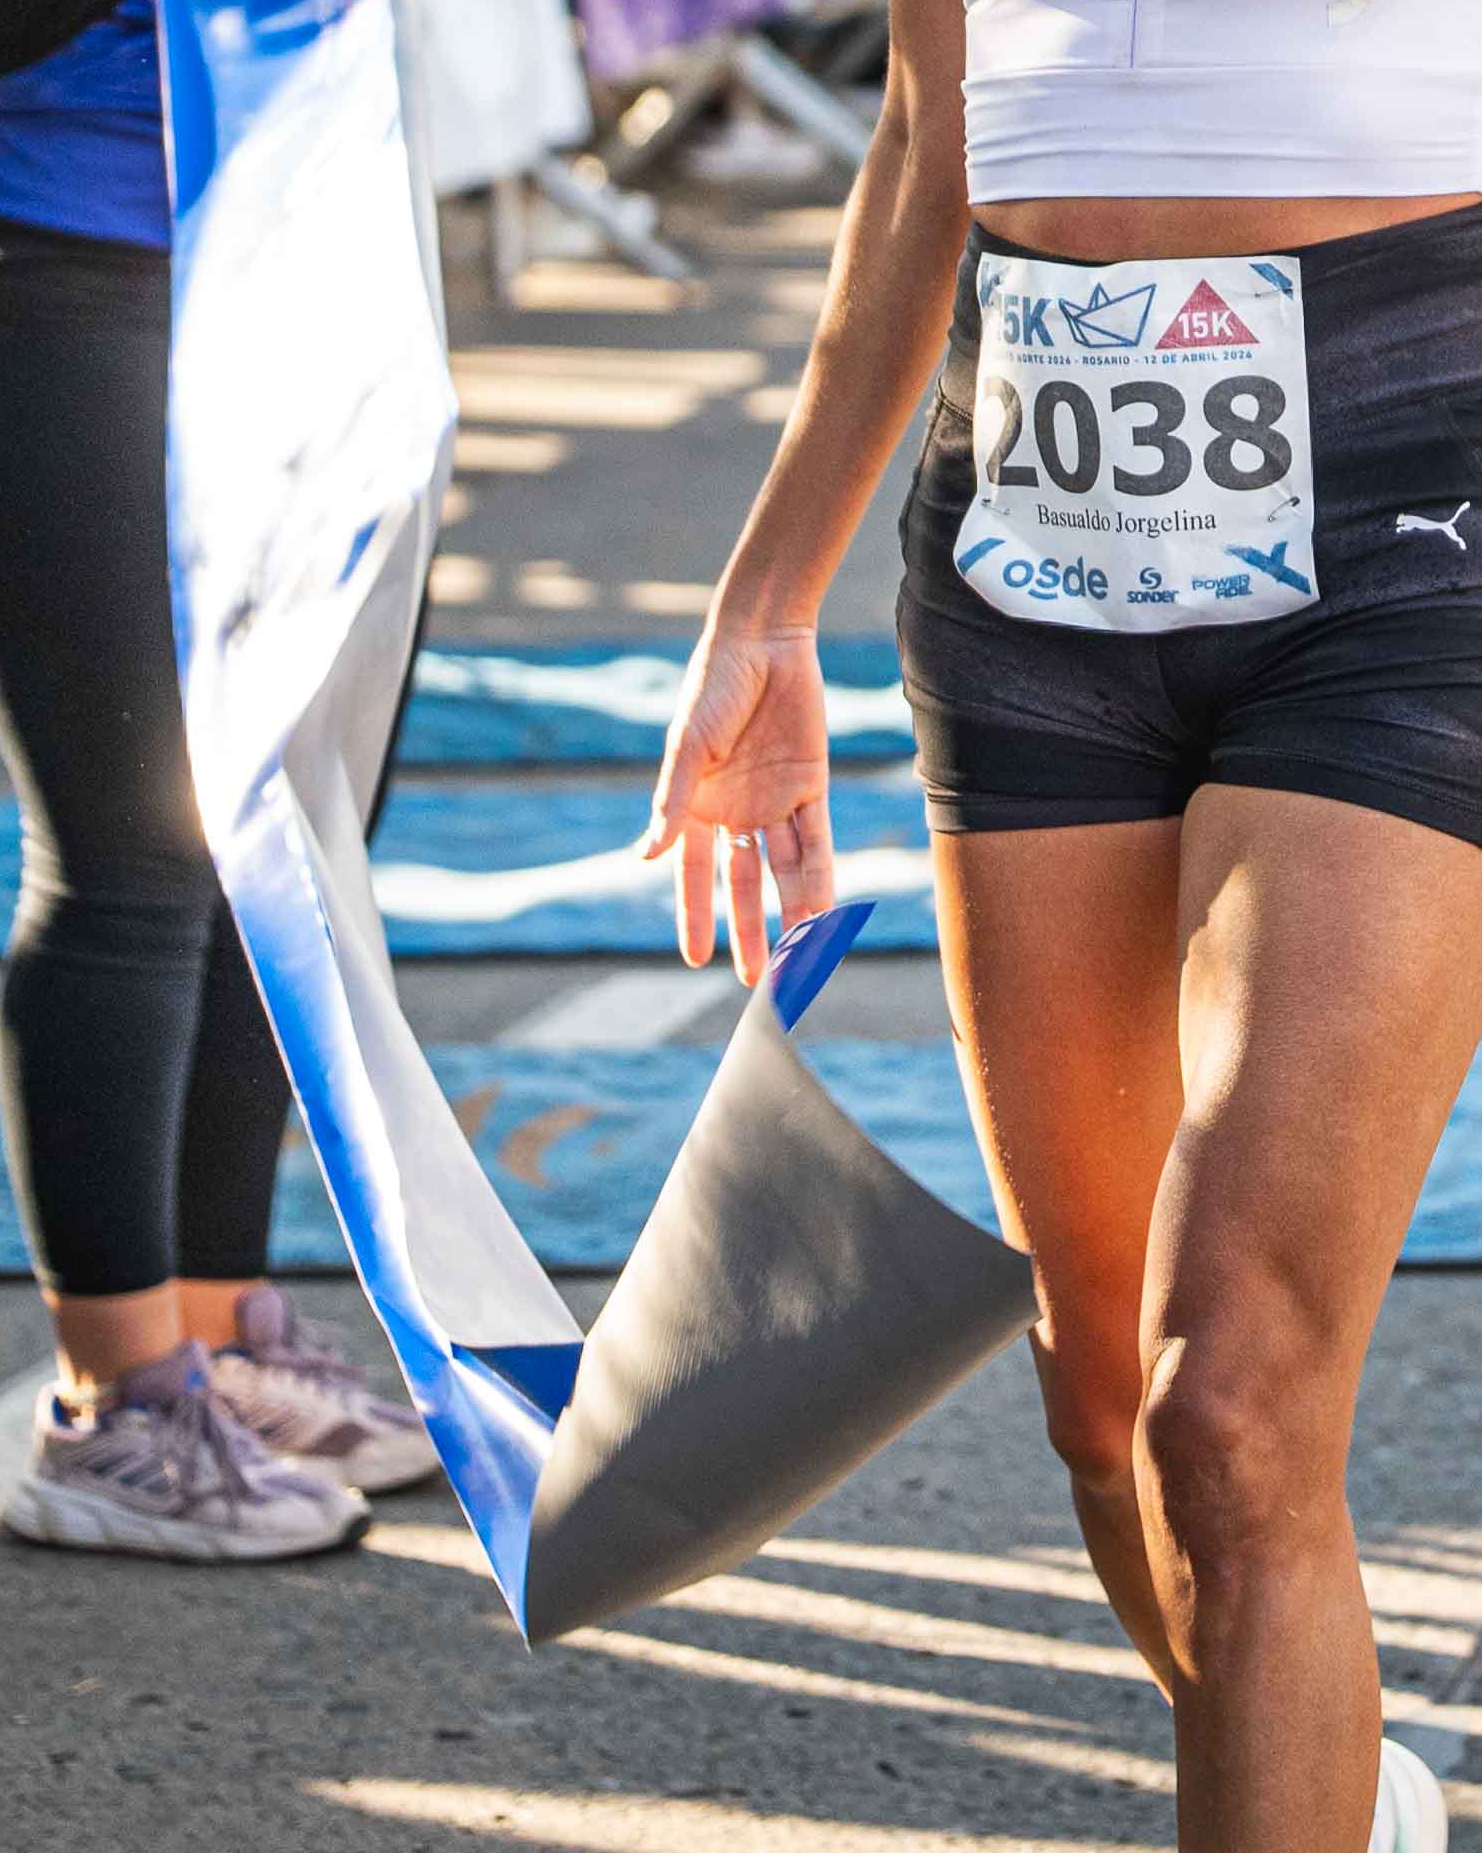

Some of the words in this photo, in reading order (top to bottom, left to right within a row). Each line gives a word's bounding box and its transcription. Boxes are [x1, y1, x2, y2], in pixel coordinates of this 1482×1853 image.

[1178, 309, 1234, 340] 15K
[1082, 356, 1130, 366] ROSARIO
[1145, 356, 1157, 365] 12
[1162, 354, 1177, 364] DE
[1182, 352, 1218, 363] ABRIL
[983, 375, 1293, 497] 2038
[1037, 503, 1111, 532] Basualdo
[1115, 510, 1217, 540] Jorgelina
[1003, 556, 1110, 600] osde
